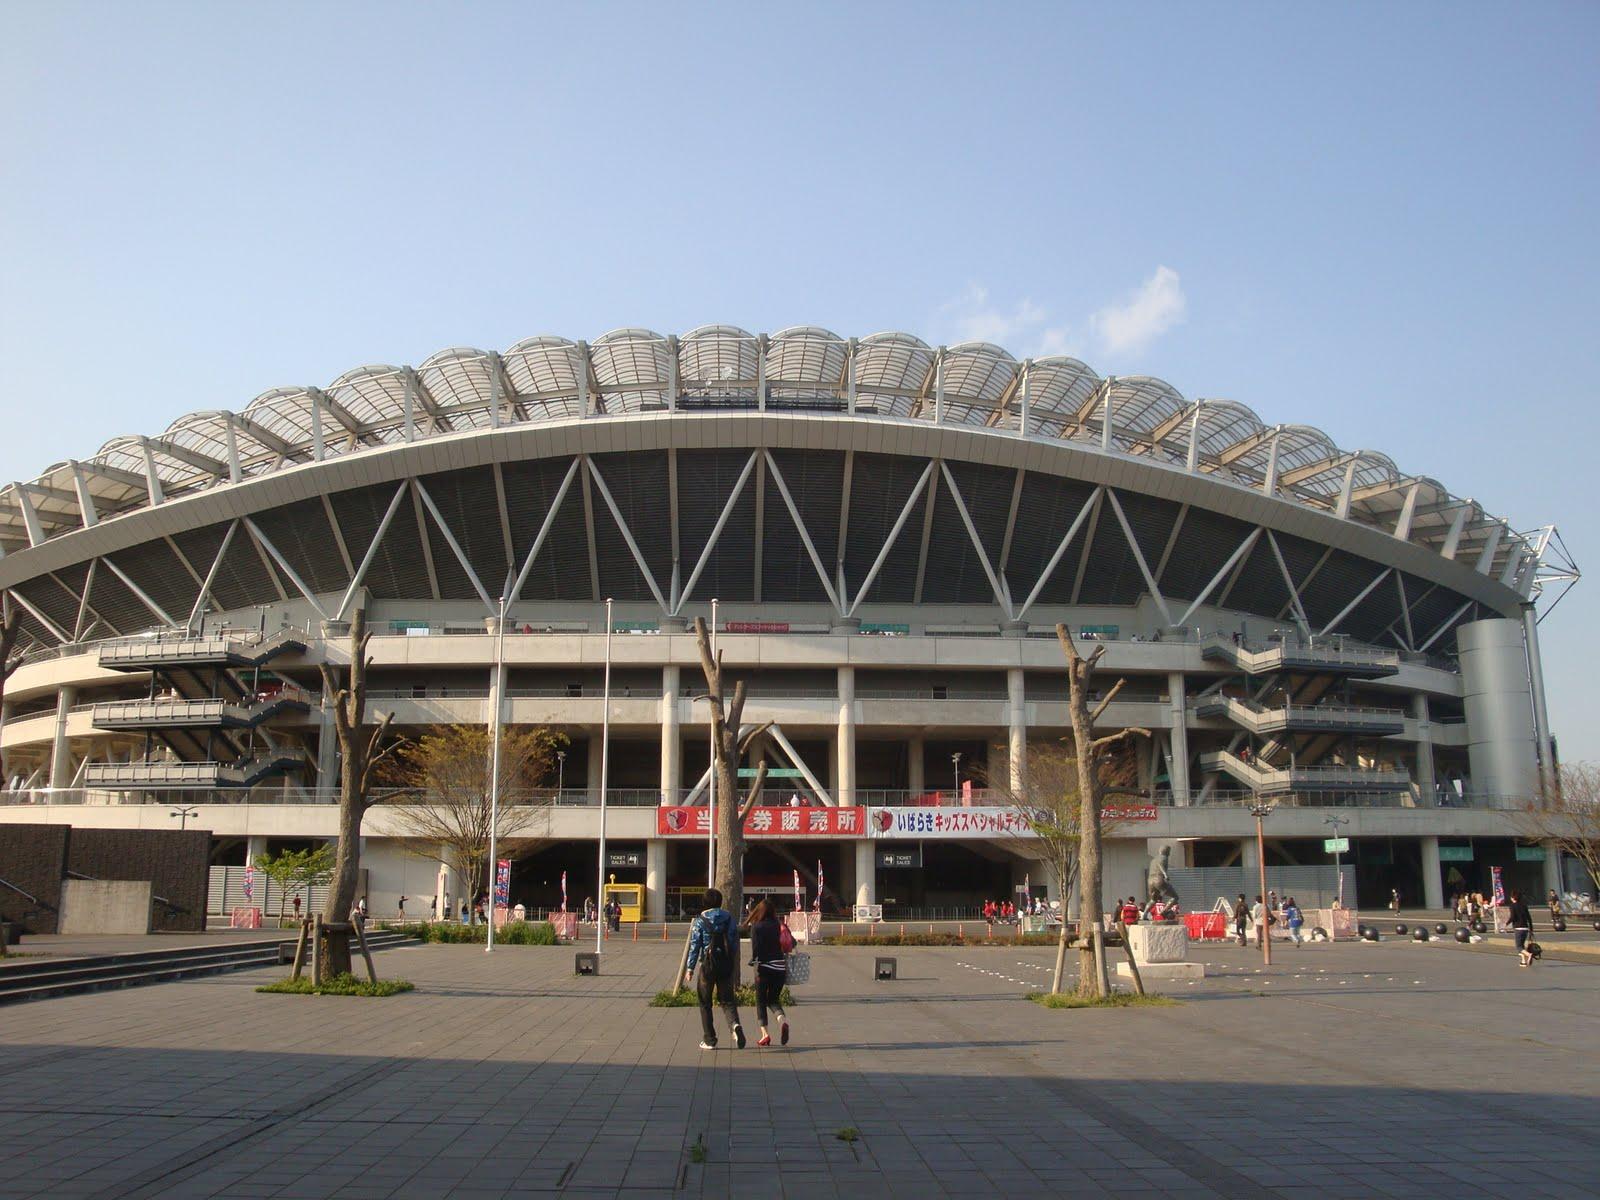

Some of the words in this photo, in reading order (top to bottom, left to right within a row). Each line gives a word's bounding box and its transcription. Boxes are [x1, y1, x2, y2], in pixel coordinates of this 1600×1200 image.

[697, 810, 856, 831] 当券販売所
